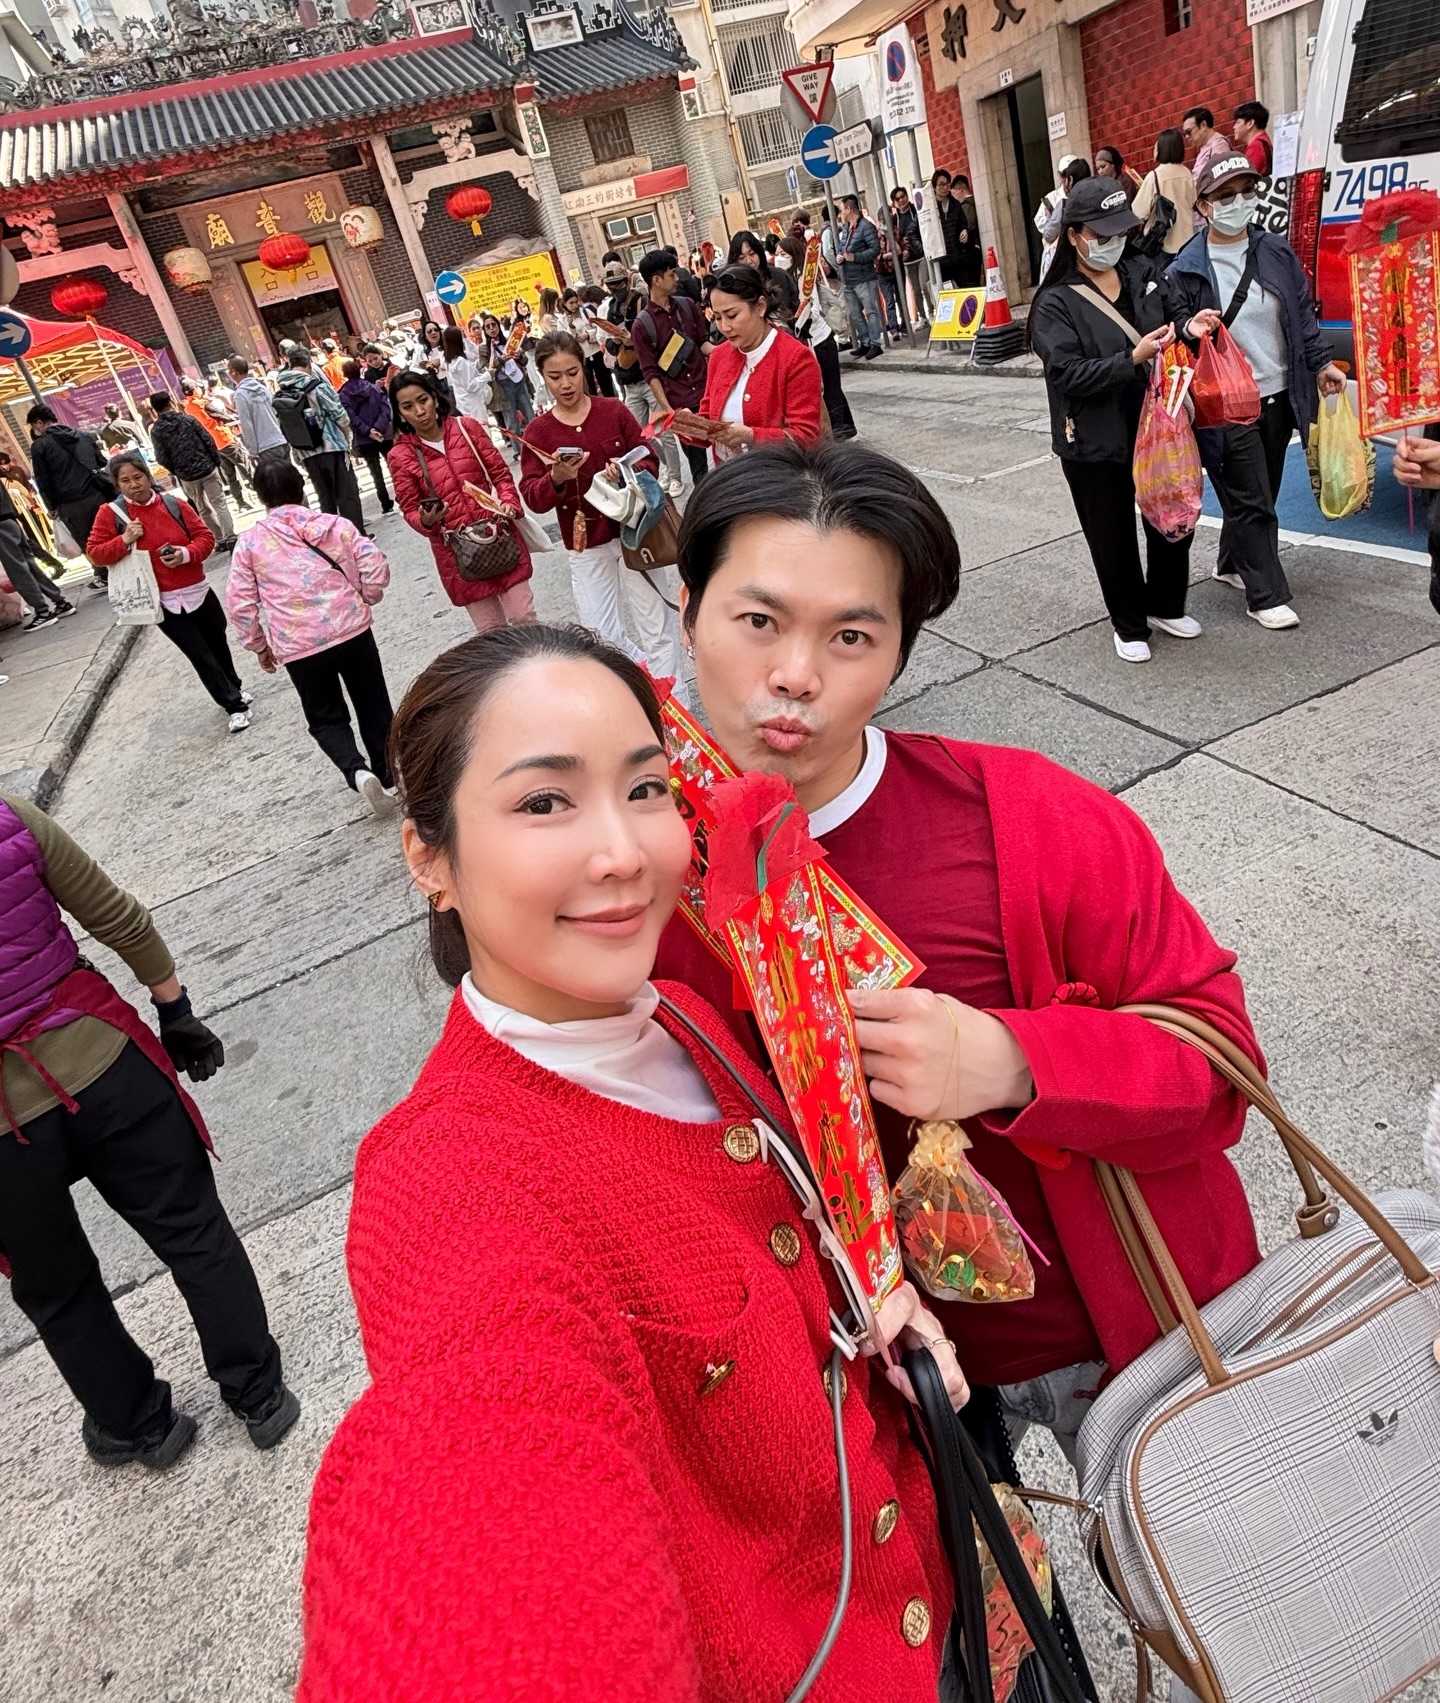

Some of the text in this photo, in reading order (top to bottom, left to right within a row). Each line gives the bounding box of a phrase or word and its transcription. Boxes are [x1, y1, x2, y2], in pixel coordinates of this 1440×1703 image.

[801, 72, 818, 82] GIVE
[803, 81, 819, 91] WAY
[205, 190, 337, 249] 觀音廟
